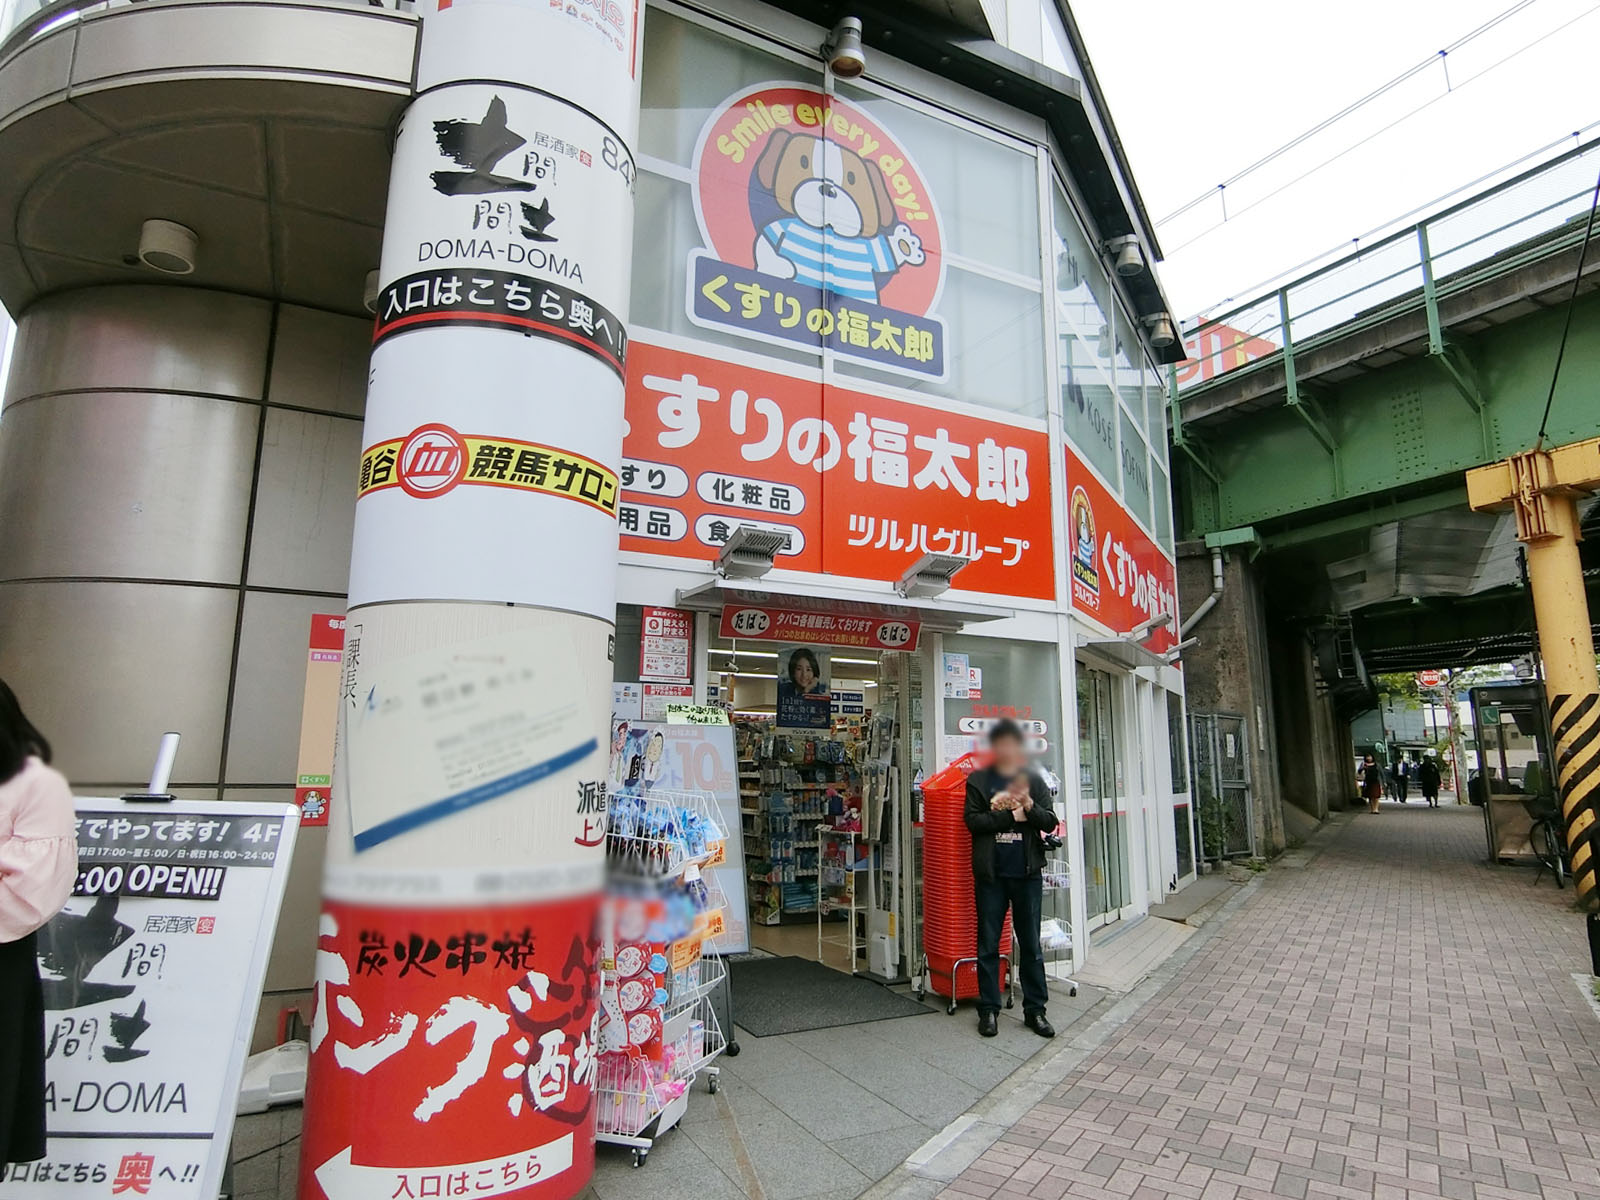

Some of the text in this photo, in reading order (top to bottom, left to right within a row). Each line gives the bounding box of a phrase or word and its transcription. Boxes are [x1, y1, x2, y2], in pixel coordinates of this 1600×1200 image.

[602, 136, 636, 195] 84
[716, 99, 929, 222] Smile every day!
[418, 239, 584, 284] DOMA-DOMA
[702, 275, 935, 362] くすりの福太郎
[623, 373, 1030, 507] すりの福太郎
[469, 444, 618, 511] 競馬サロン
[712, 477, 791, 511] 化粧品
[847, 513, 1031, 567] ツルハグループ
[734, 611, 768, 631] たばこ
[879, 624, 909, 643] たばこ
[243, 822, 283, 844] 4F
[356, 926, 537, 978] 炭火串焼
[392, 1155, 542, 1200] 入口はこちら
